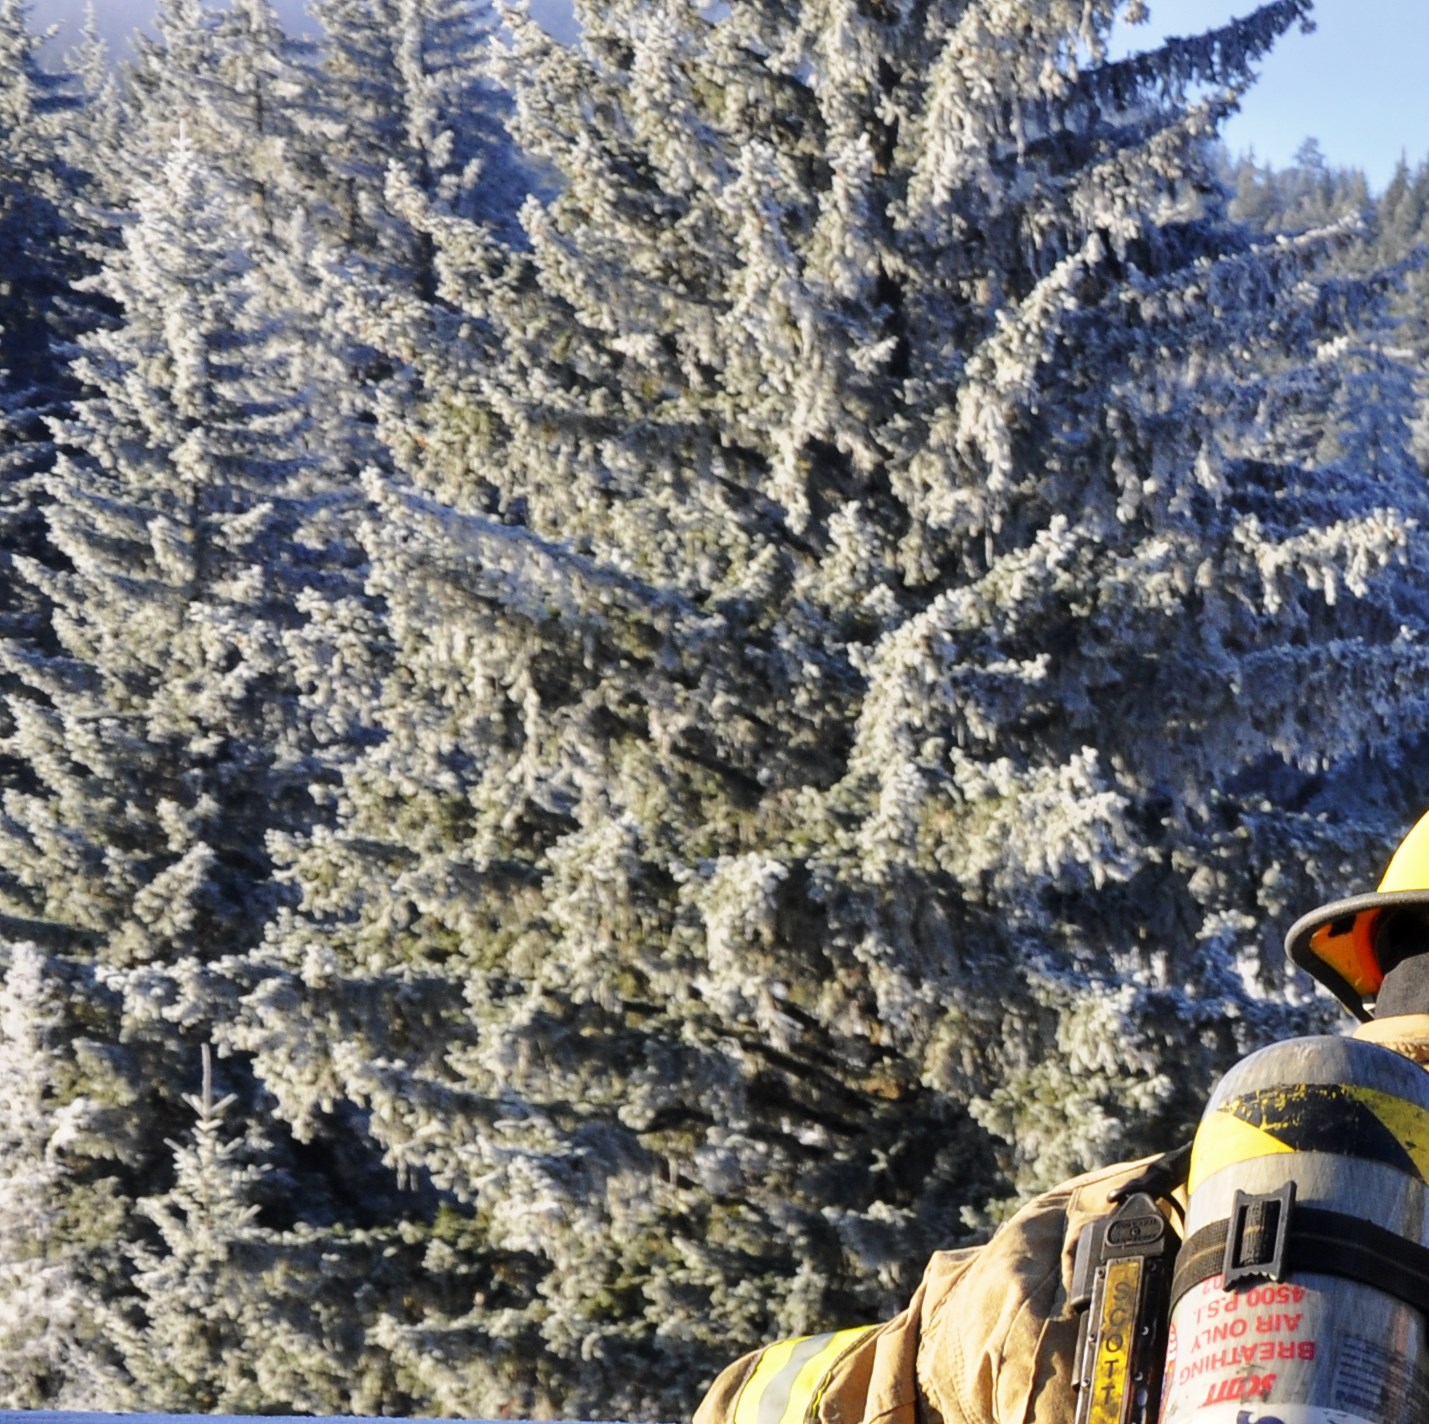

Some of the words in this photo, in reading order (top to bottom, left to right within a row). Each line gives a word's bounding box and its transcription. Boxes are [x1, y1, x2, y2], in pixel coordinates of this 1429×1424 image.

[1246, 1284, 1308, 1307] 4500
[1190, 1317, 1248, 1354] ONLY
[1256, 1312, 1303, 1334] AIR
[1100, 1282, 1130, 1406] SCOTT
[1179, 1340, 1318, 1386] BREATHING
